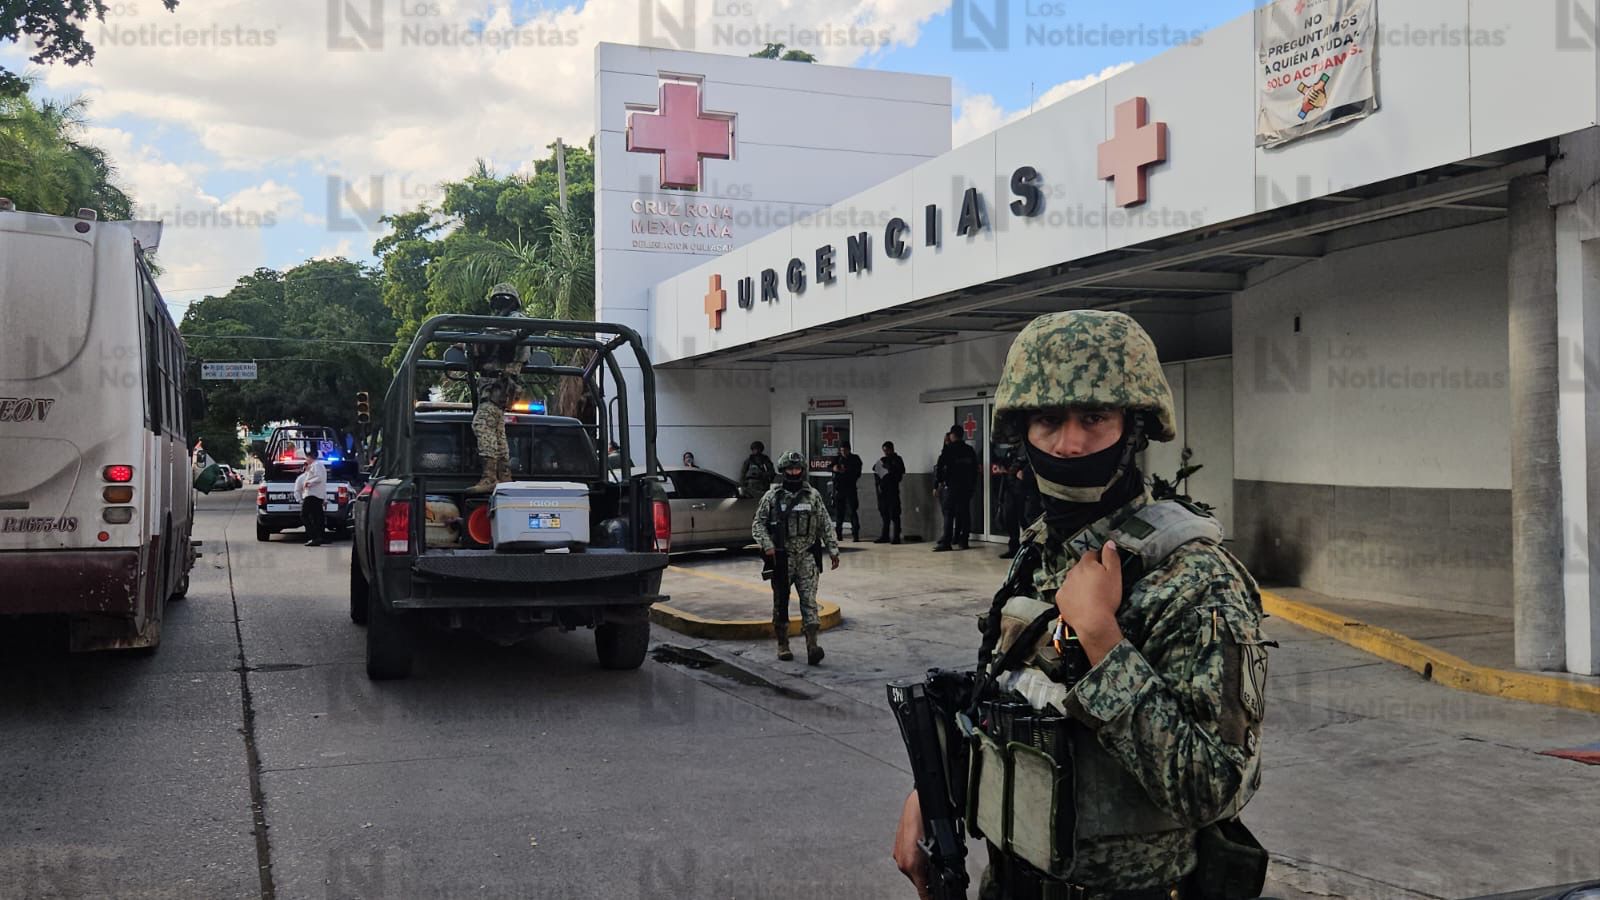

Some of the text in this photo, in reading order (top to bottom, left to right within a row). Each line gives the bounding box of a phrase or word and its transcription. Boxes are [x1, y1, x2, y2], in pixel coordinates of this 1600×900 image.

[1304, 14, 1322, 29] NO
[631, 199, 733, 219] CRUZ ROJA
[631, 219, 733, 238] MEXICANA
[738, 165, 1042, 310] URGENCIAS
